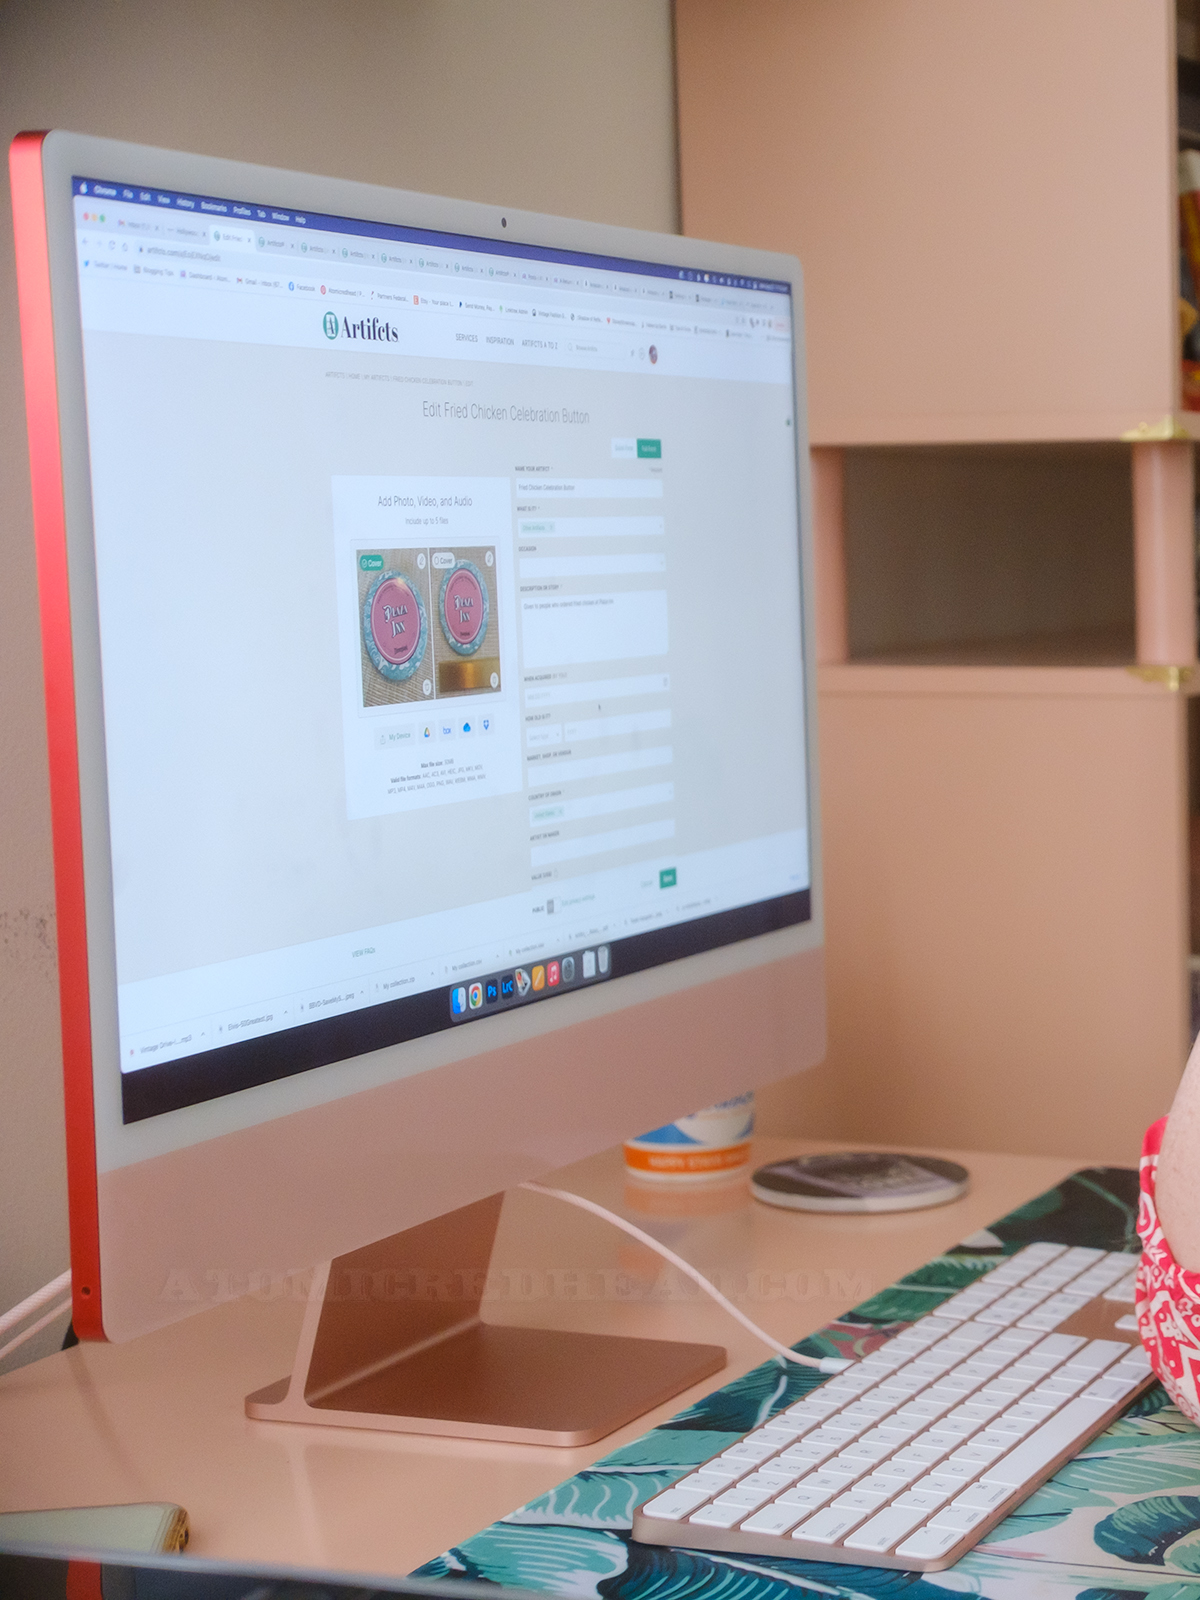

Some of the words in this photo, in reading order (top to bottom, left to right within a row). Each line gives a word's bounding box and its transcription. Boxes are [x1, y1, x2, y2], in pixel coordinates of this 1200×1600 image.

[93, 185, 117, 197] Chrome
[139, 192, 152, 202] Edit
[157, 194, 171, 204] View
[176, 197, 195, 209] History
[200, 201, 228, 213] Bookmarks
[232, 206, 252, 216] Profiles
[257, 209, 266, 218] Tab
[271, 212, 290, 222] Window
[295, 215, 307, 225] Help
[143, 266, 163, 276] Blogging
[296, 283, 316, 292] Facebook
[328, 287, 356, 297] Atomicredhead
[377, 293, 393, 301] Partners
[420, 297, 428, 305] Etsy
[431, 298, 439, 306] Your
[341, 316, 399, 343] Artifcts
[455, 333, 478, 343] SERVICES
[486, 336, 514, 346] INSPIRATION
[521, 339, 543, 349] ARTIFCTS
[325, 371, 345, 379] ARTIFCTS
[371, 374, 390, 382] ARTIFCTS
[392, 375, 404, 383] FRIED
[404, 376, 422, 384] CHICKEN
[422, 377, 447, 385] CELEBRATION
[423, 400, 441, 418] Edit
[444, 402, 468, 419] Fried
[470, 403, 508, 420] Chicken
[509, 405, 560, 423] Celebration
[562, 408, 590, 424] Button
[518, 483, 528, 491] Fried
[378, 496, 392, 507] Add
[393, 496, 416, 508] Photo,
[417, 496, 439, 508] Video,
[440, 496, 452, 506] and
[454, 495, 473, 506] Audio
[405, 517, 422, 525] Include
[423, 518, 428, 526] up
[429, 517, 435, 525] to
[367, 559, 382, 567] Cover
[440, 556, 453, 565] Cover
[454, 595, 474, 611] PLAZA
[539, 602, 551, 610] people
[382, 604, 408, 623] PLAZA
[442, 726, 452, 735] box
[389, 733, 397, 742] My
[397, 732, 411, 740] Device
[390, 776, 400, 784] Valid
[352, 949, 364, 958] VIEW
[364, 946, 376, 956] FAQs
[382, 982, 390, 990] My
[487, 984, 497, 998] Ps
[502, 979, 513, 994] LrC
[965, 1512, 980, 1523] option
